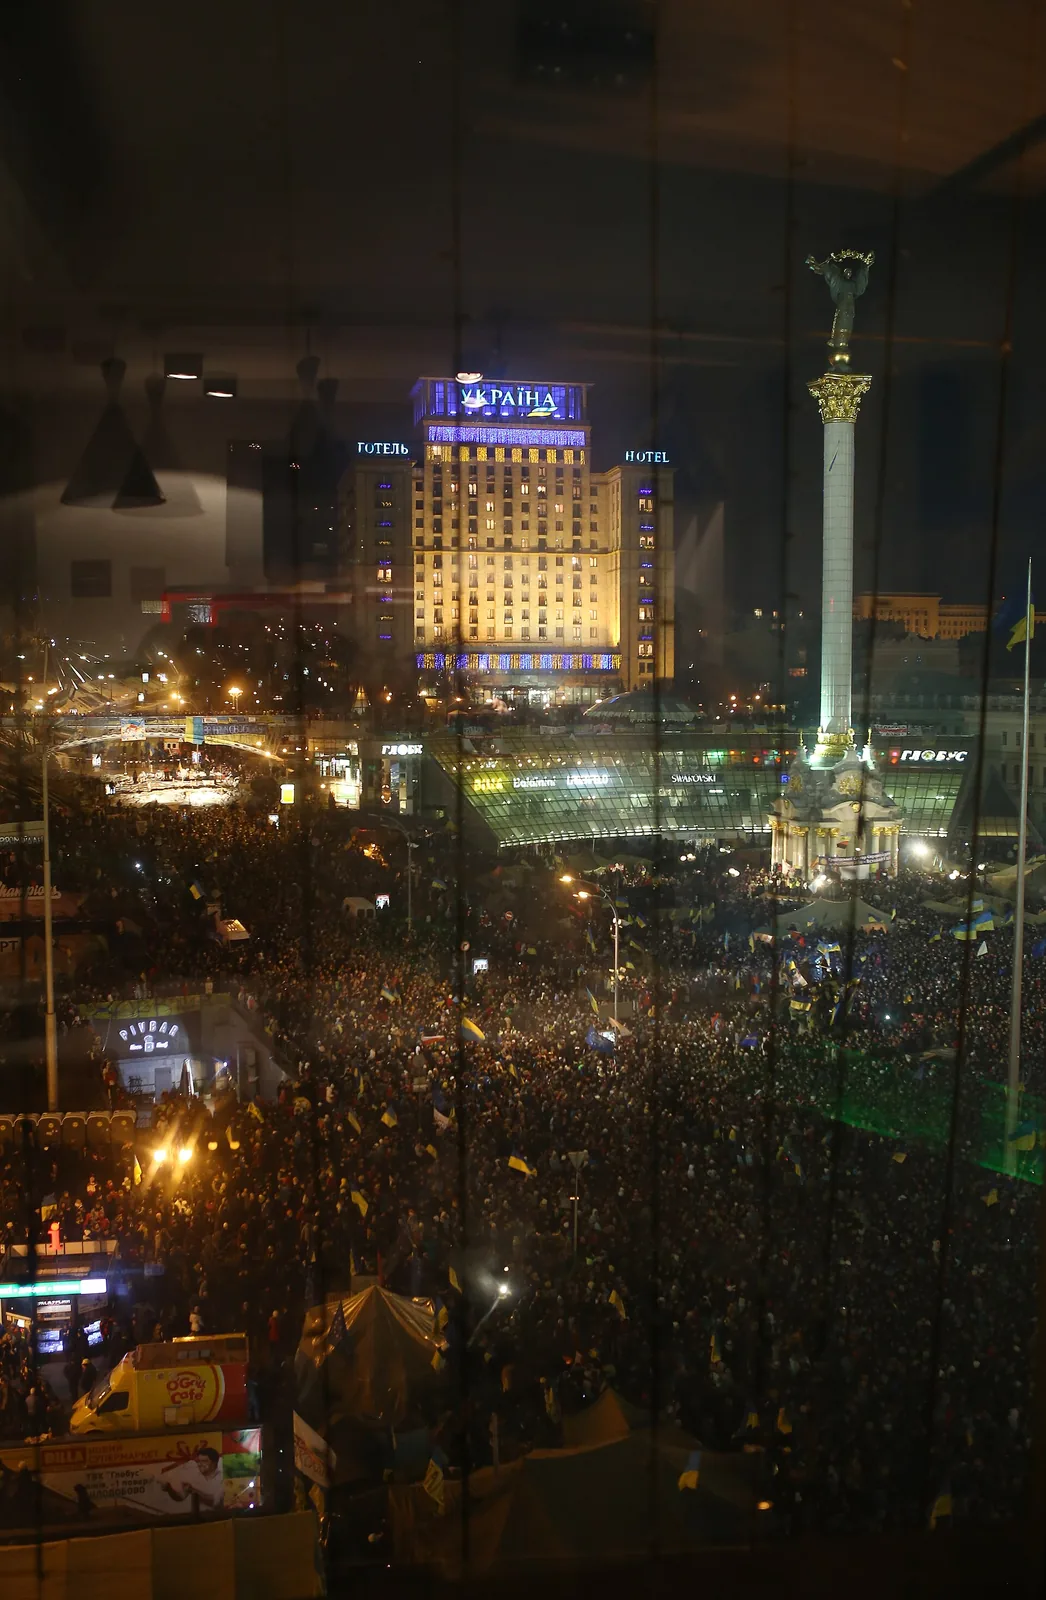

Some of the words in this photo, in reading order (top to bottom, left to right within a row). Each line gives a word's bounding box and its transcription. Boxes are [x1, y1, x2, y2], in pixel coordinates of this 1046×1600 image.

[461, 387, 556, 407] УКРАЇНА
[357, 441, 410, 455] ГОТЕЛЬ
[625, 450, 670, 463] HOTEL
[900, 749, 968, 762] ГЛОБУС
[119, 1020, 179, 1041] PIVBAR
[44, 1450, 84, 1465] BILLA
